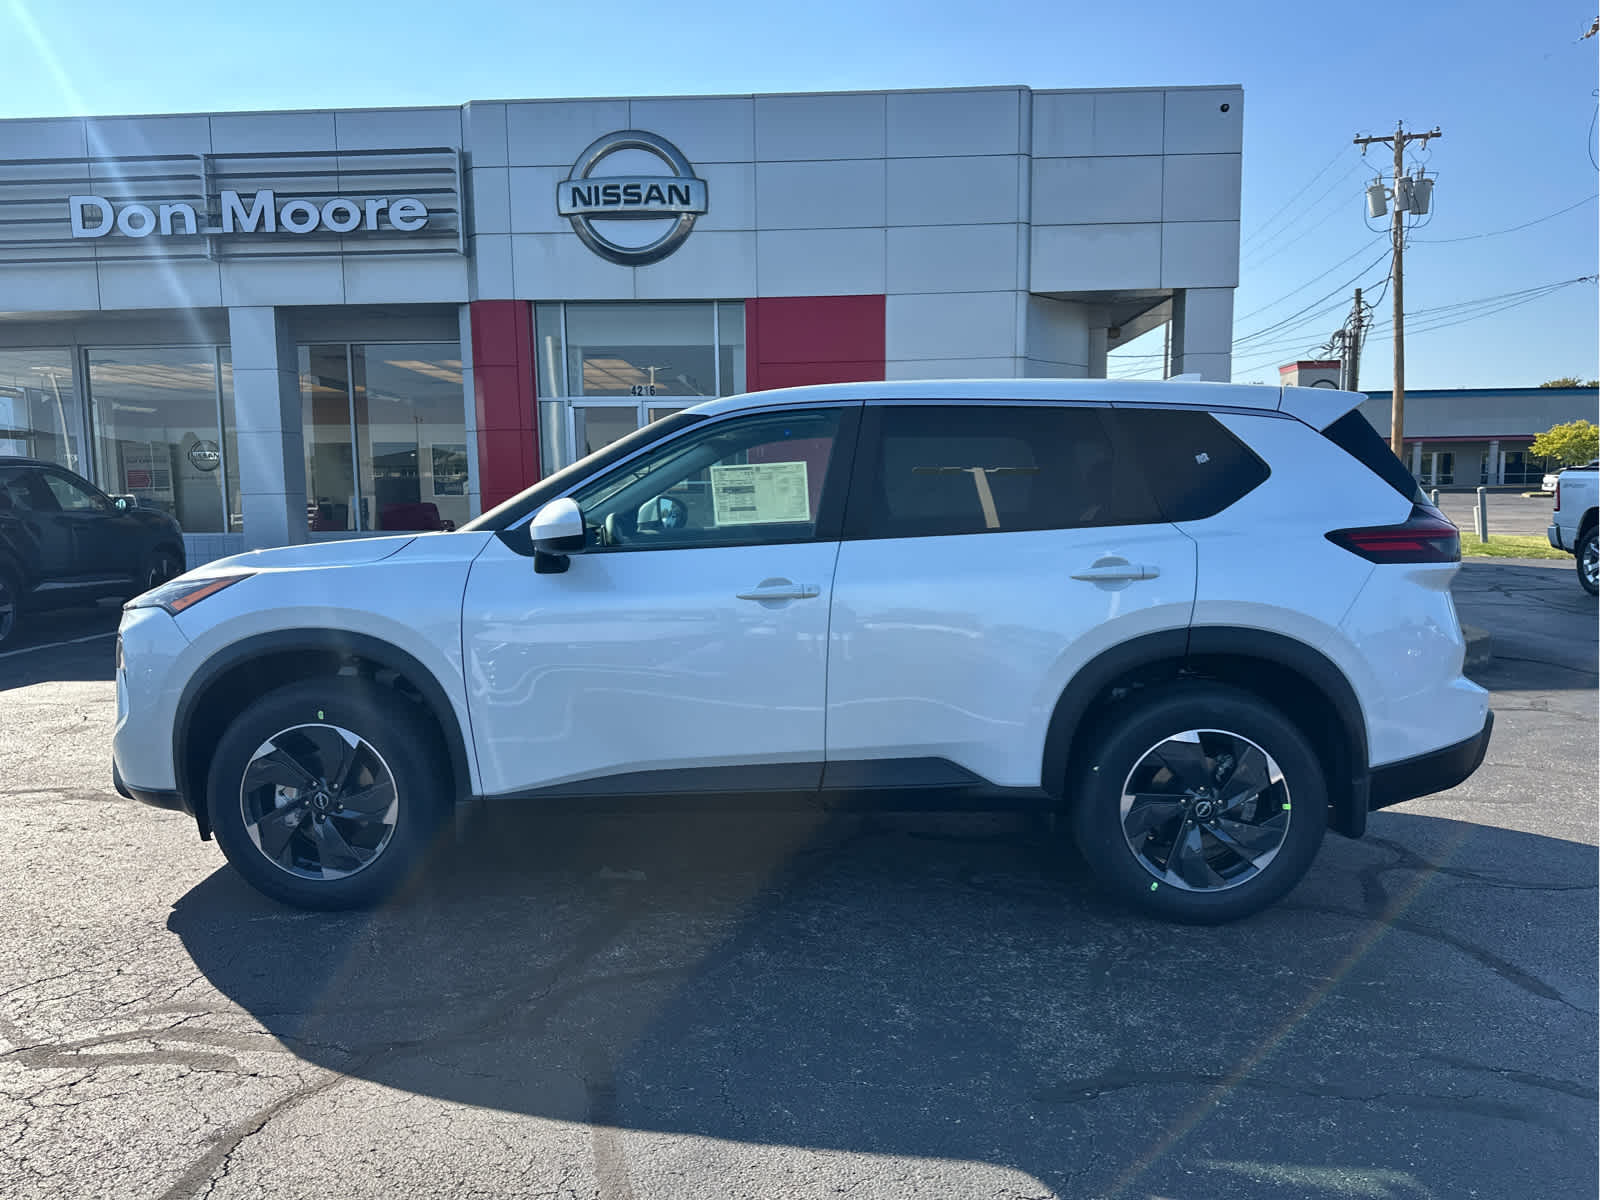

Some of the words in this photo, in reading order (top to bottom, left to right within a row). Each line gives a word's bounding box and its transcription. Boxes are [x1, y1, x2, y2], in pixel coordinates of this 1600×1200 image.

[69, 195, 196, 238] Don
[220, 189, 429, 234] Moore
[571, 184, 691, 207] NISSAN
